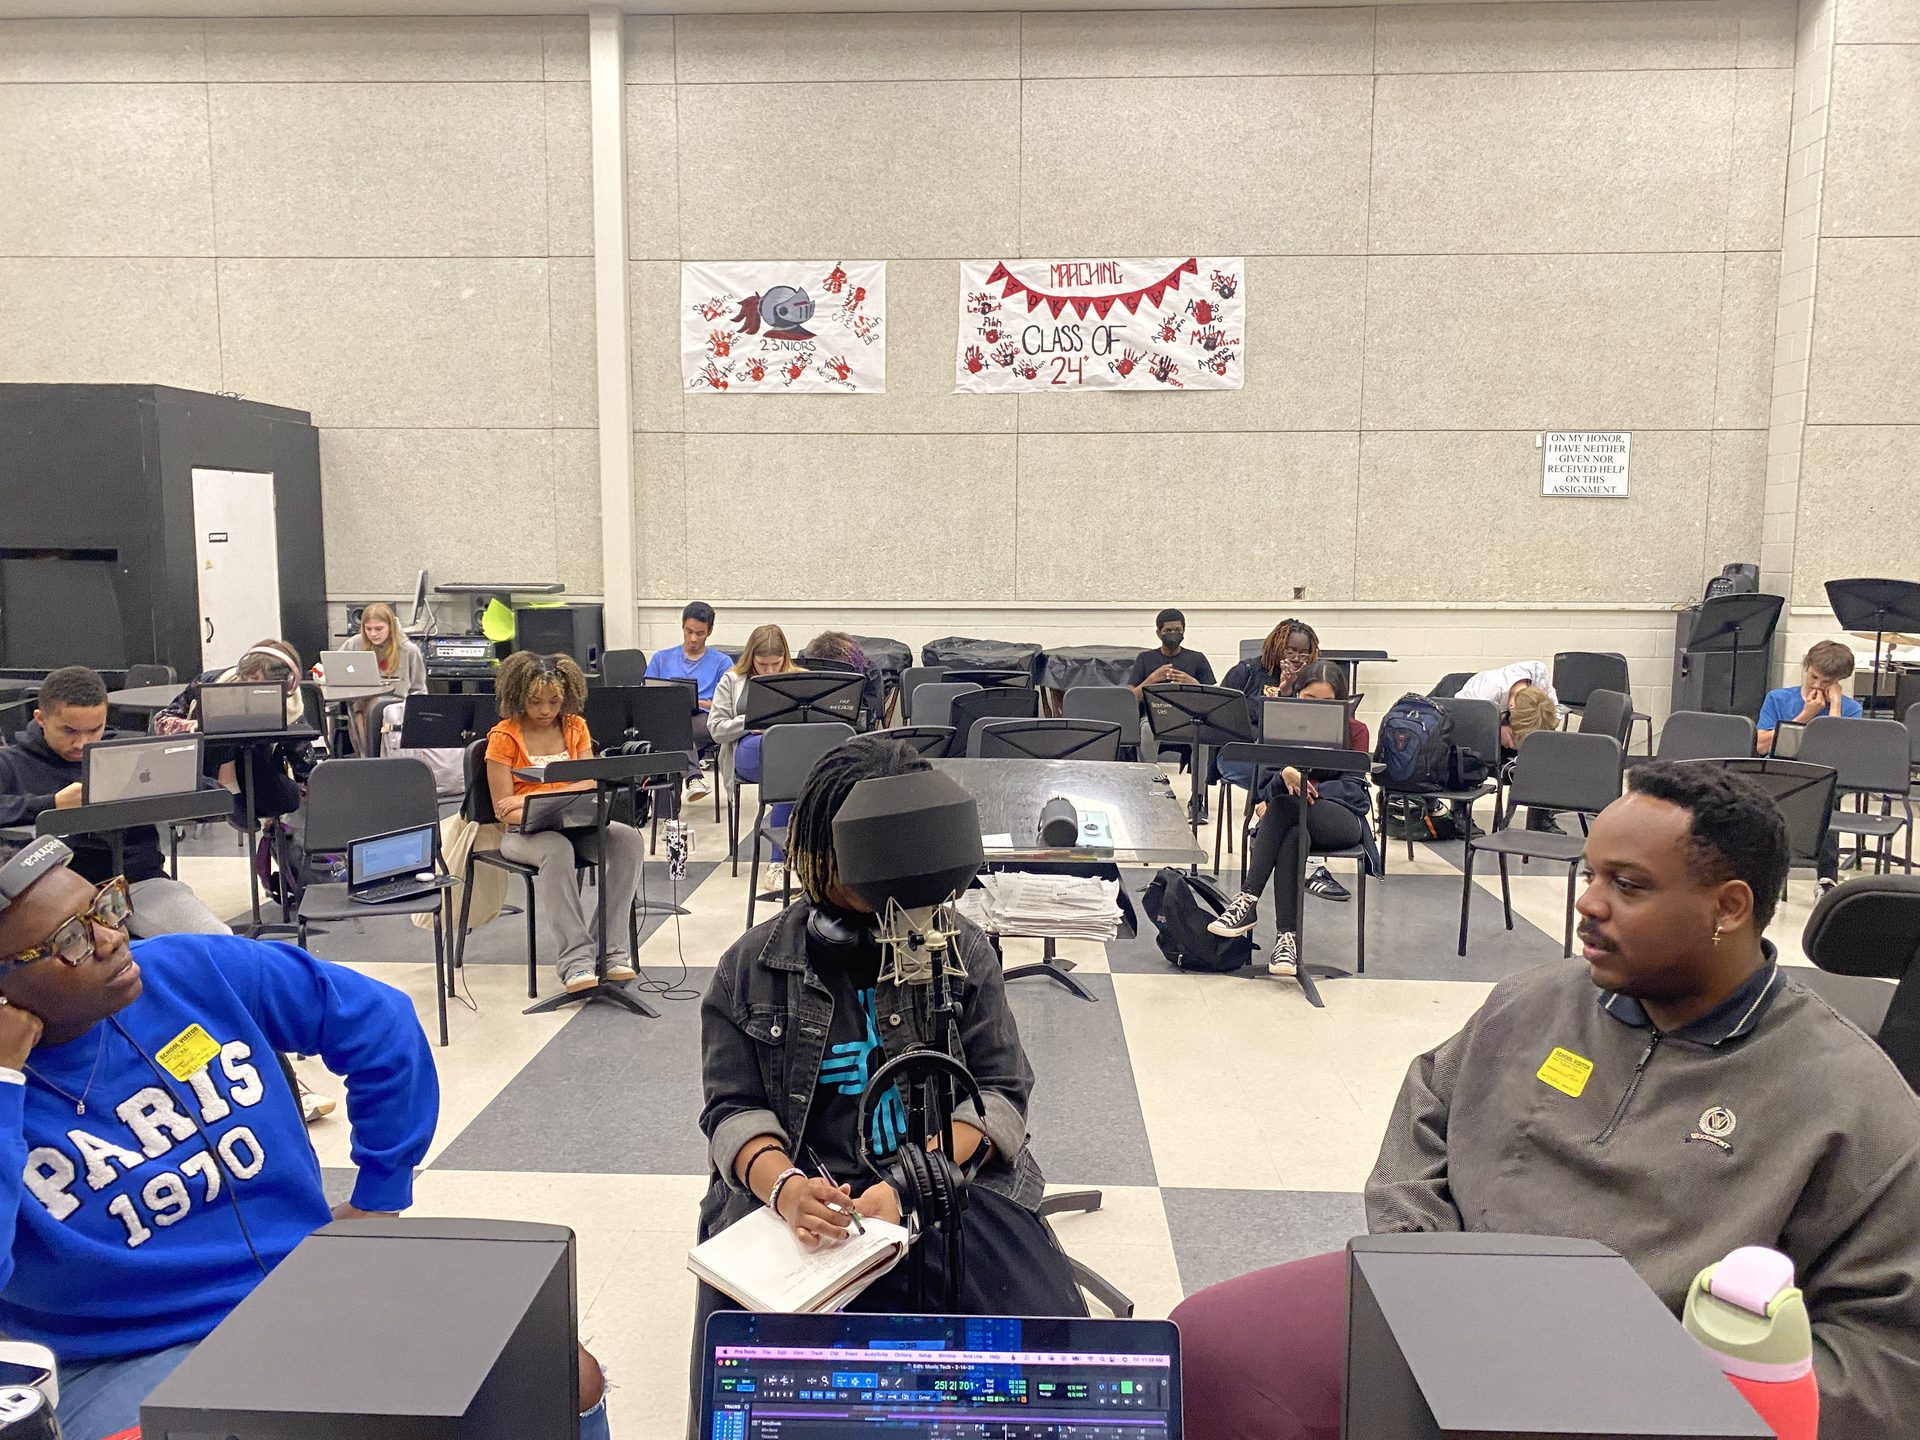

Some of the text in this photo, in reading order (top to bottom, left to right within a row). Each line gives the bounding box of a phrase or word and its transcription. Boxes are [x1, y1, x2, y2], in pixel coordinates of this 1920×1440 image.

[1022, 324, 1083, 355] CLASS
[1092, 325, 1127, 356] OF
[1551, 434, 1566, 442] ON
[1569, 434, 1584, 442] MY
[1554, 444, 1581, 452] HAVE
[1583, 444, 1626, 453] NEITHER
[1559, 455, 1614, 463] GIVEN NOR
[1547, 465, 1625, 473] RECEIVED HELP
[1565, 475, 1605, 483] ON THIS
[160, 1043, 180, 1060] SCHOOL
[179, 1026, 199, 1044] VISITOR
[23, 1040, 264, 1221] PARIS
[108, 1125, 265, 1248] 1970
